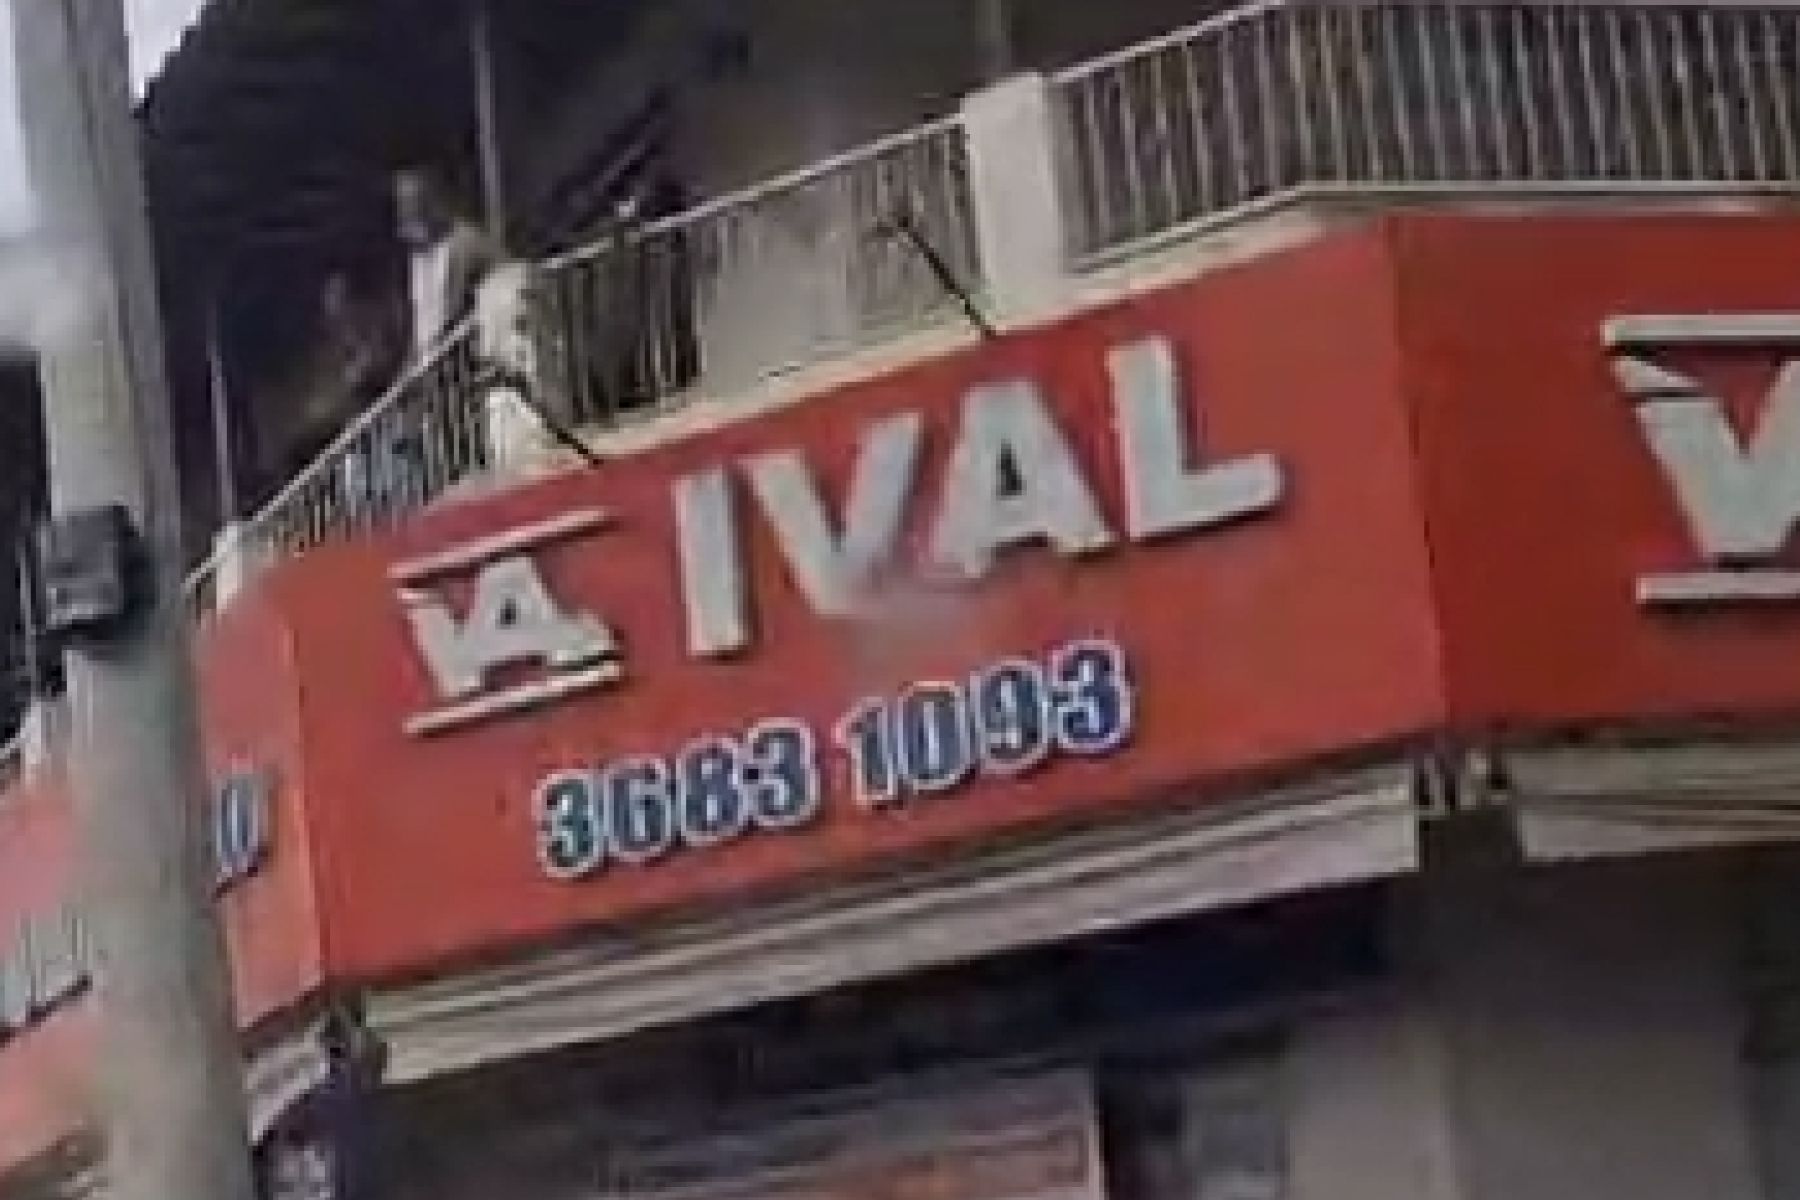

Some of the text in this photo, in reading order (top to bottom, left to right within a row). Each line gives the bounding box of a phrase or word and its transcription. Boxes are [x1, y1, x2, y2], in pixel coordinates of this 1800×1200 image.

[673, 334, 1284, 656] IVAL
[534, 636, 1133, 880] 3683 1093
